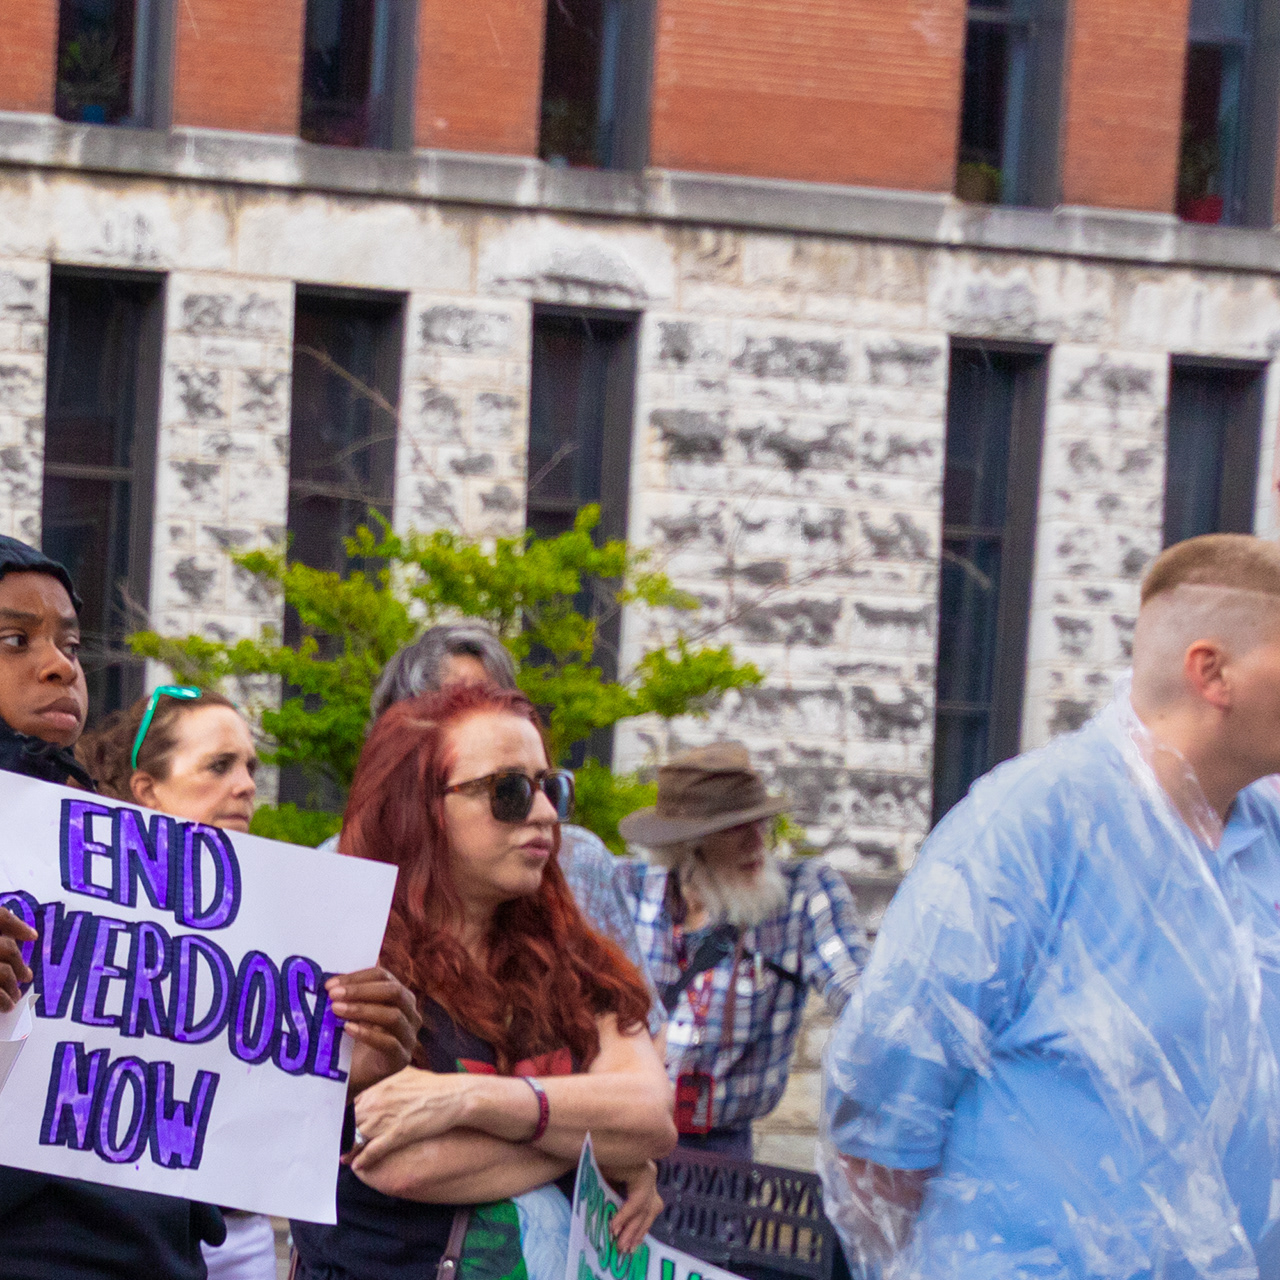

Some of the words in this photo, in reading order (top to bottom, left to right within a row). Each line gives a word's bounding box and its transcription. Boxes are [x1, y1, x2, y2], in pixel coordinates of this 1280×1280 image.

[59, 798, 242, 931] END
[39, 1041, 220, 1171] NOW
[663, 1203, 822, 1262] OUISVILLE
